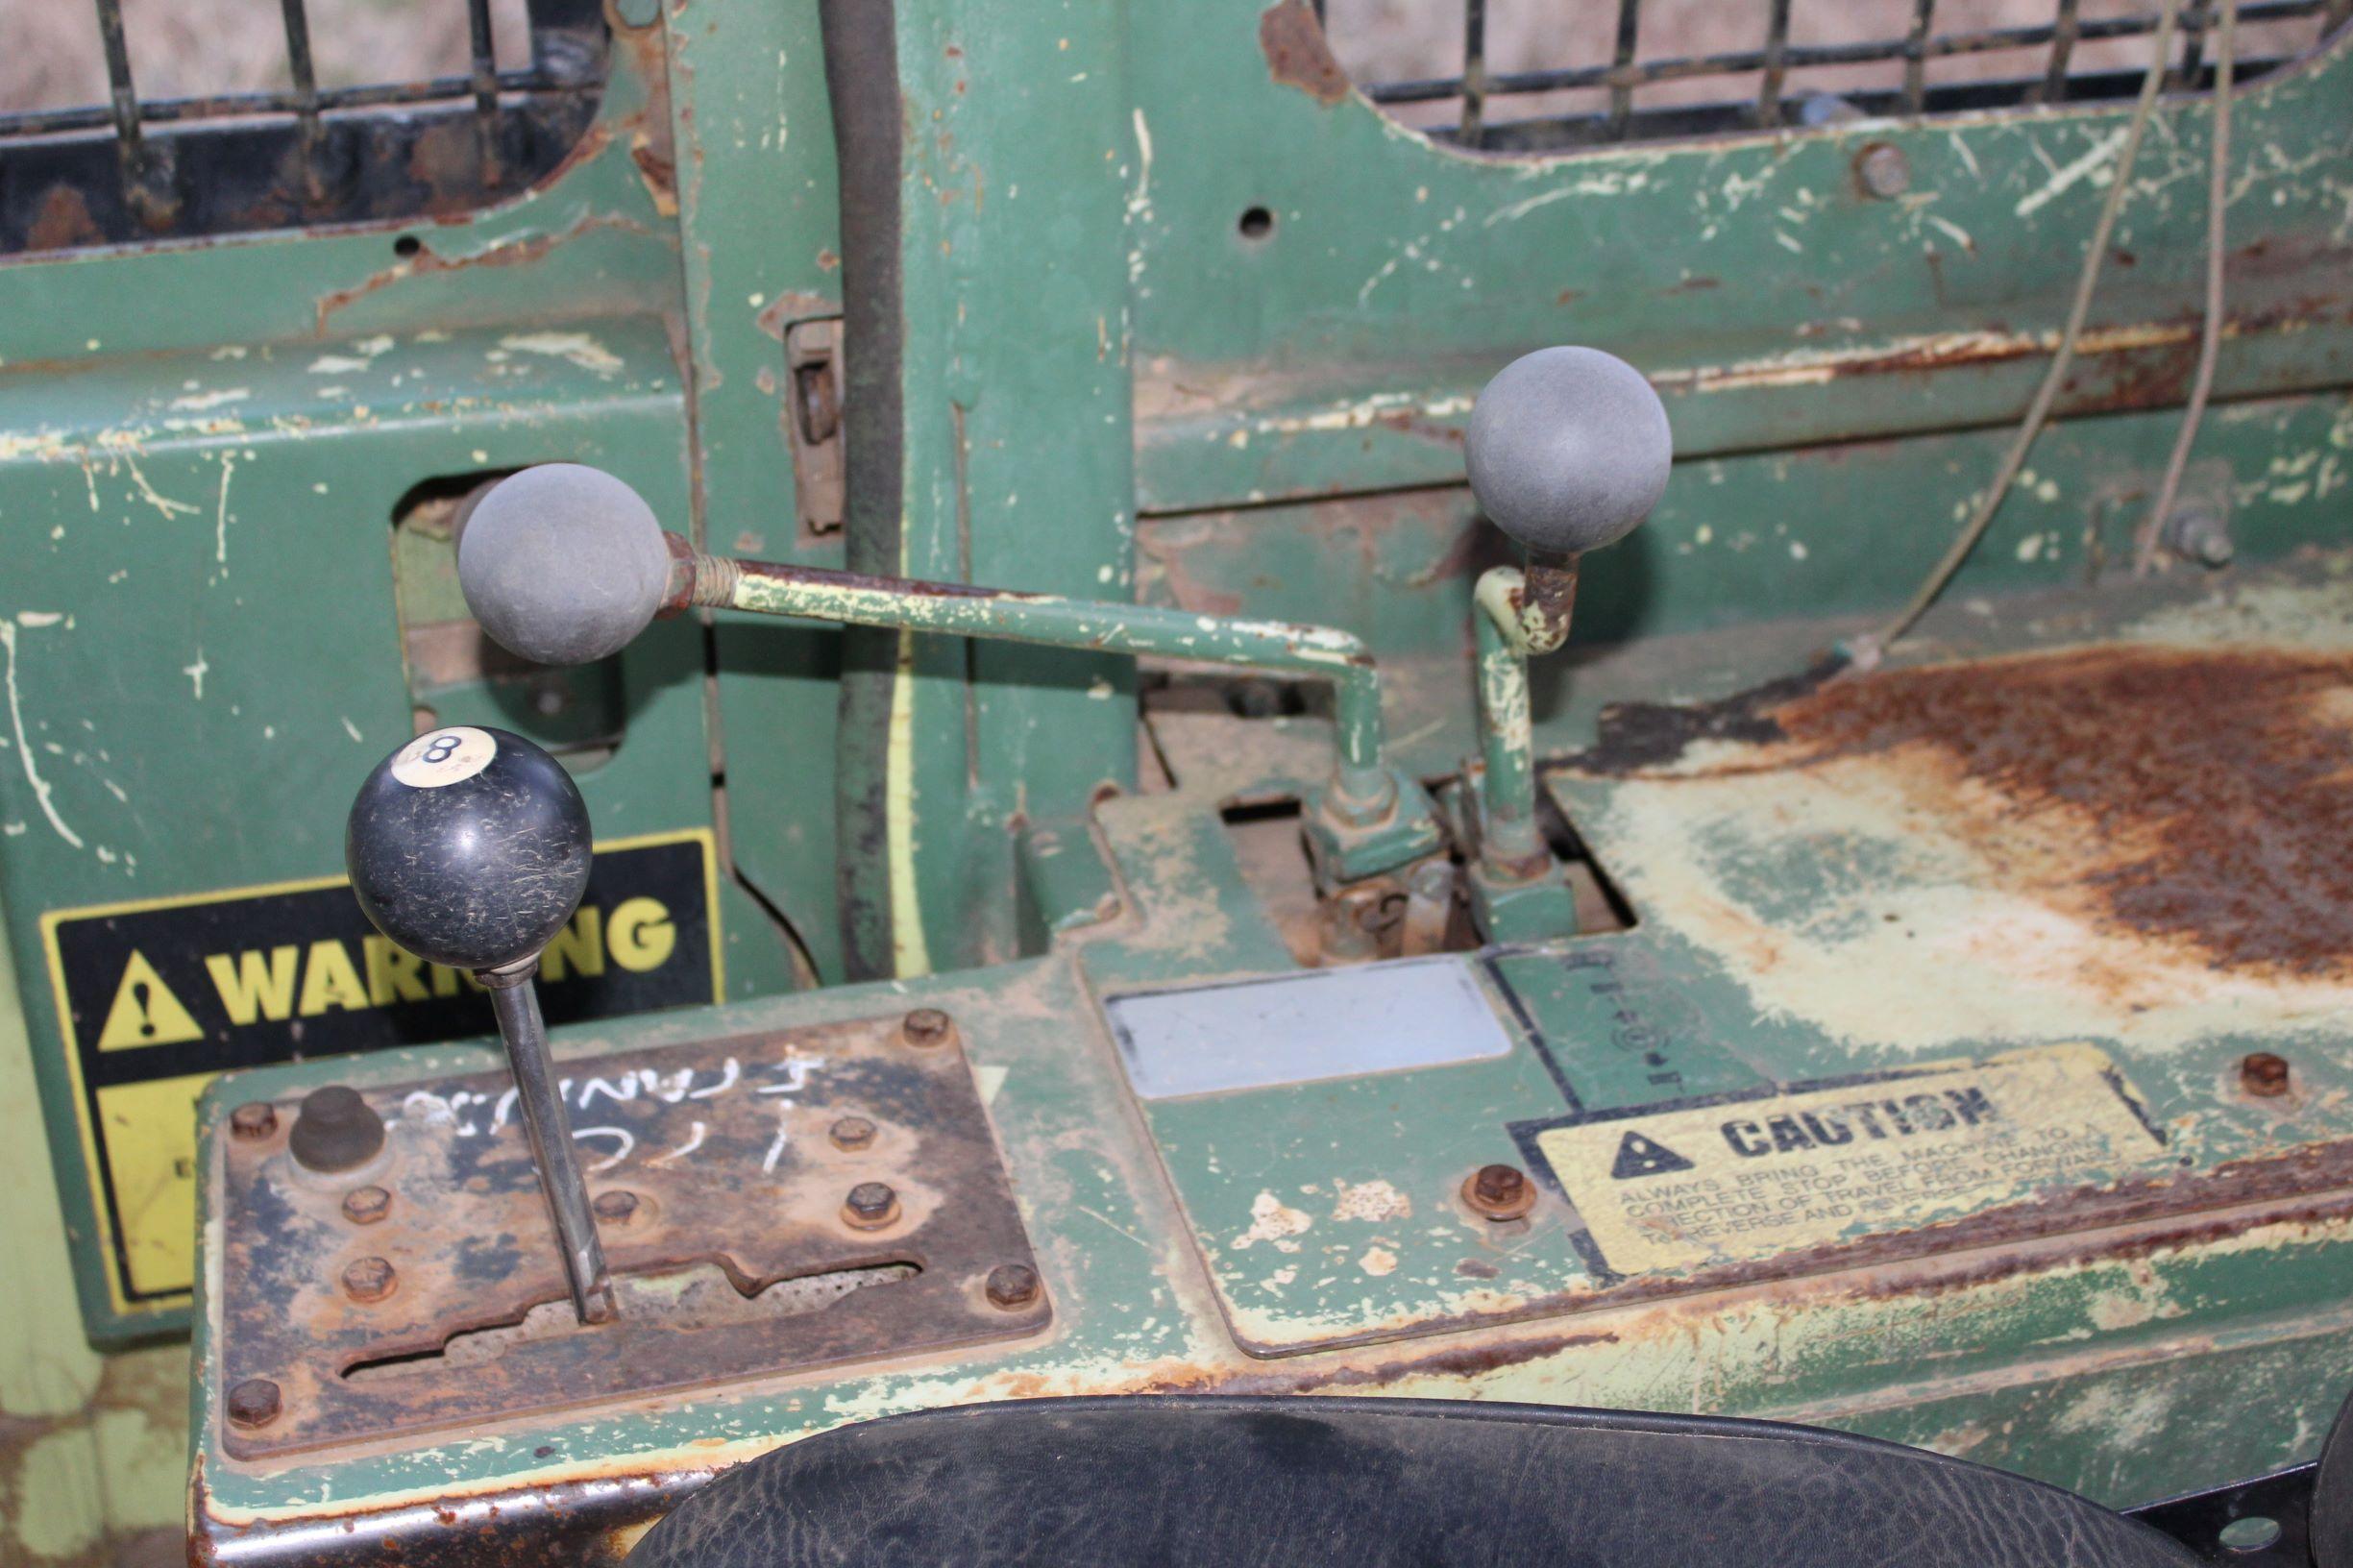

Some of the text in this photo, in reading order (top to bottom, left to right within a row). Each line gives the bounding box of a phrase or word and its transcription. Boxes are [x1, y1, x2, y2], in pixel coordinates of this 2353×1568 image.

[423, 736, 461, 763] 8
[1720, 1087, 1998, 1159] CAUTION
[1621, 1179, 1721, 1205] ALWAYS
[1735, 1164, 1819, 1188] BRING
[1831, 1153, 1886, 1171] THE
[1626, 1187, 1766, 1218] COMPLETE
[1780, 1173, 1848, 1197] STOP
[1864, 1157, 1969, 1183] BEFORE
[1778, 1194, 1812, 1211] OF
[1825, 1181, 1917, 1205] TRAVEL
[1924, 1167, 1994, 1189] FROM
[1683, 1212, 1797, 1241] REVERSE
[1804, 1203, 1853, 1223] AND
